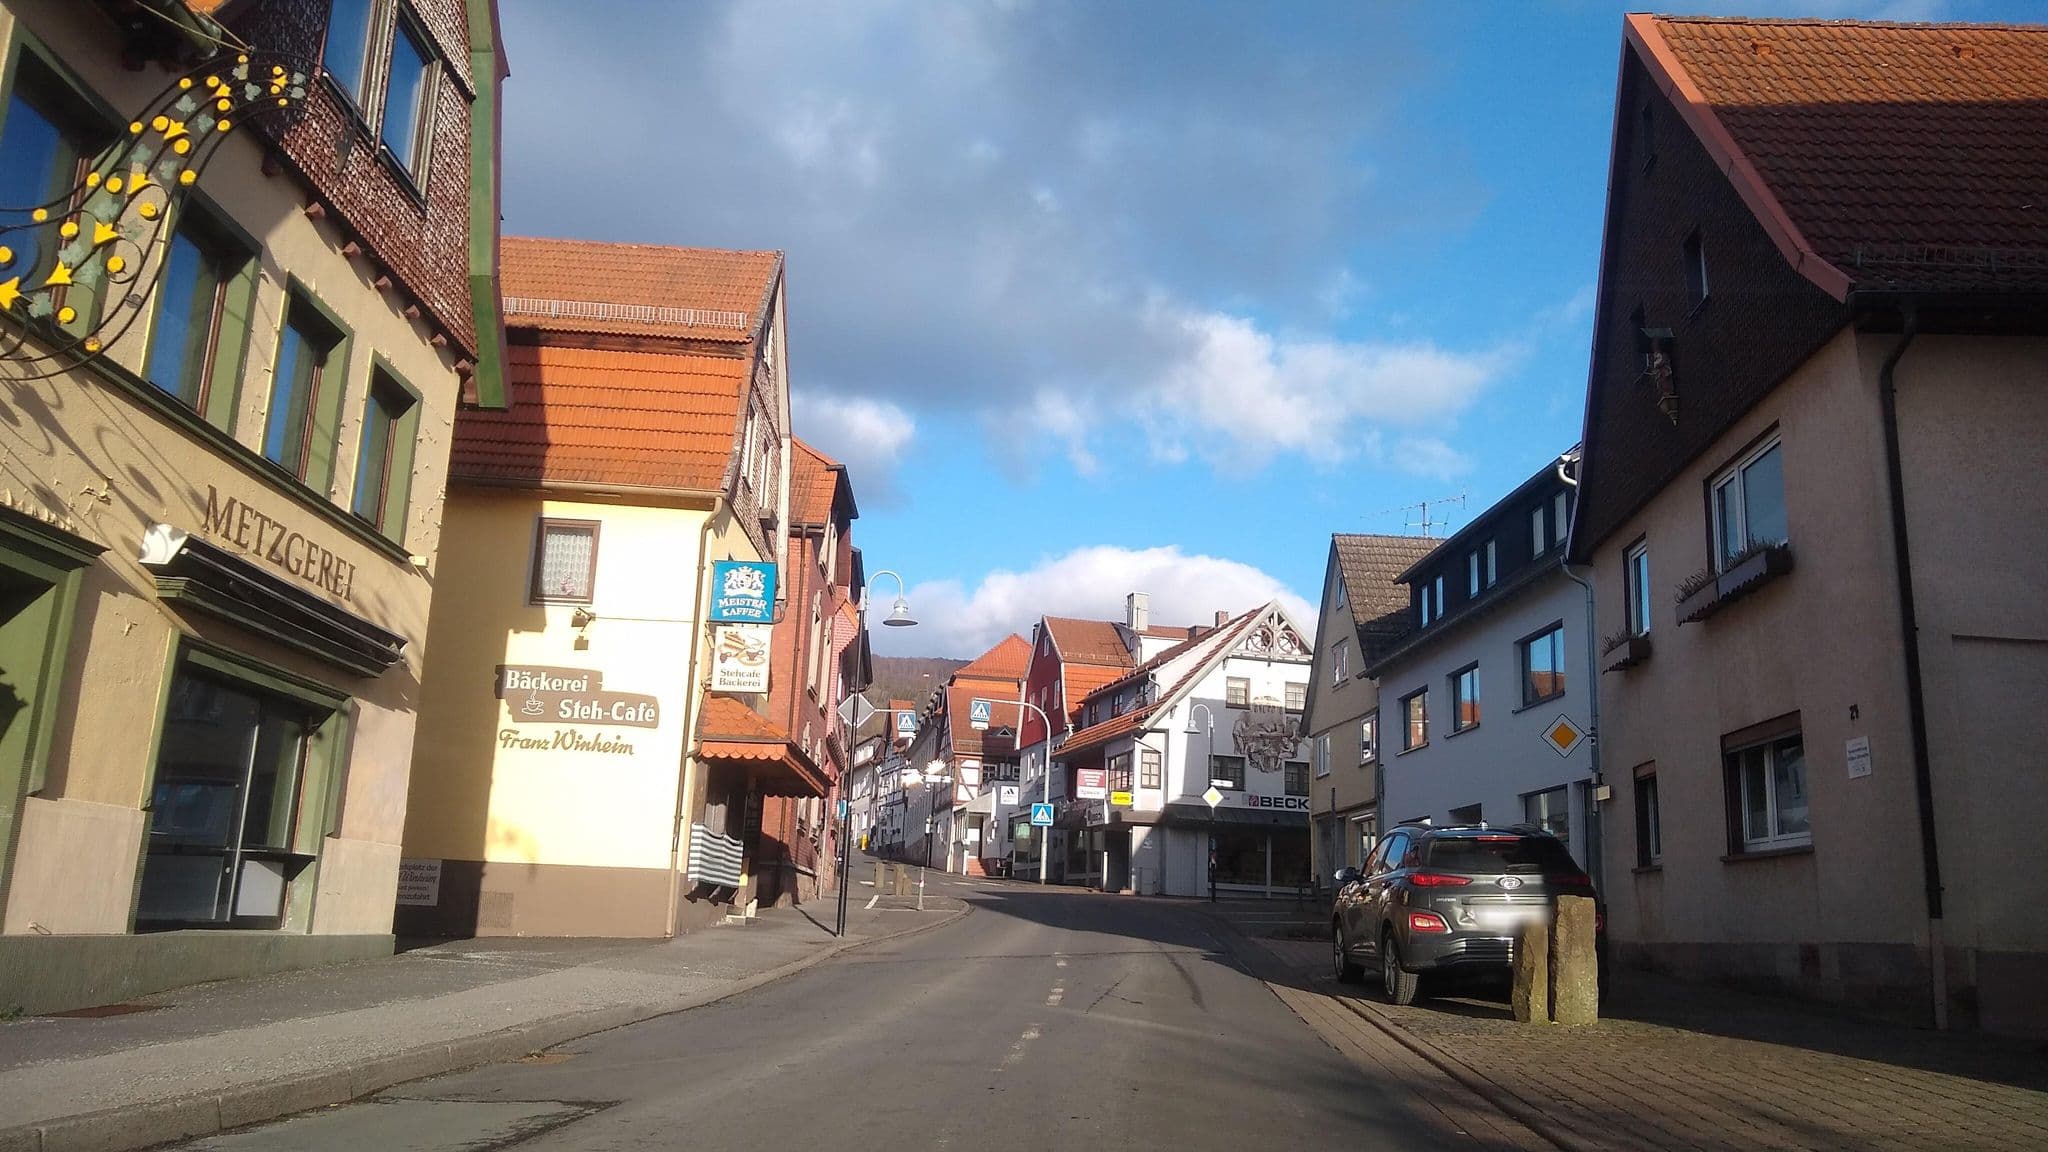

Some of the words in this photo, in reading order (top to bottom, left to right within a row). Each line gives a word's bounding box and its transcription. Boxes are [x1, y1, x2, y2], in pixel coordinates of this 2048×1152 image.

[202, 484, 356, 602] METZGEREI
[718, 597, 767, 609] MEISTER
[722, 607, 762, 618] KAFFEE
[505, 669, 588, 692] Bäckerei
[558, 699, 656, 722] Steh-Café
[499, 728, 549, 750] Franz
[551, 729, 634, 756] Winheim
